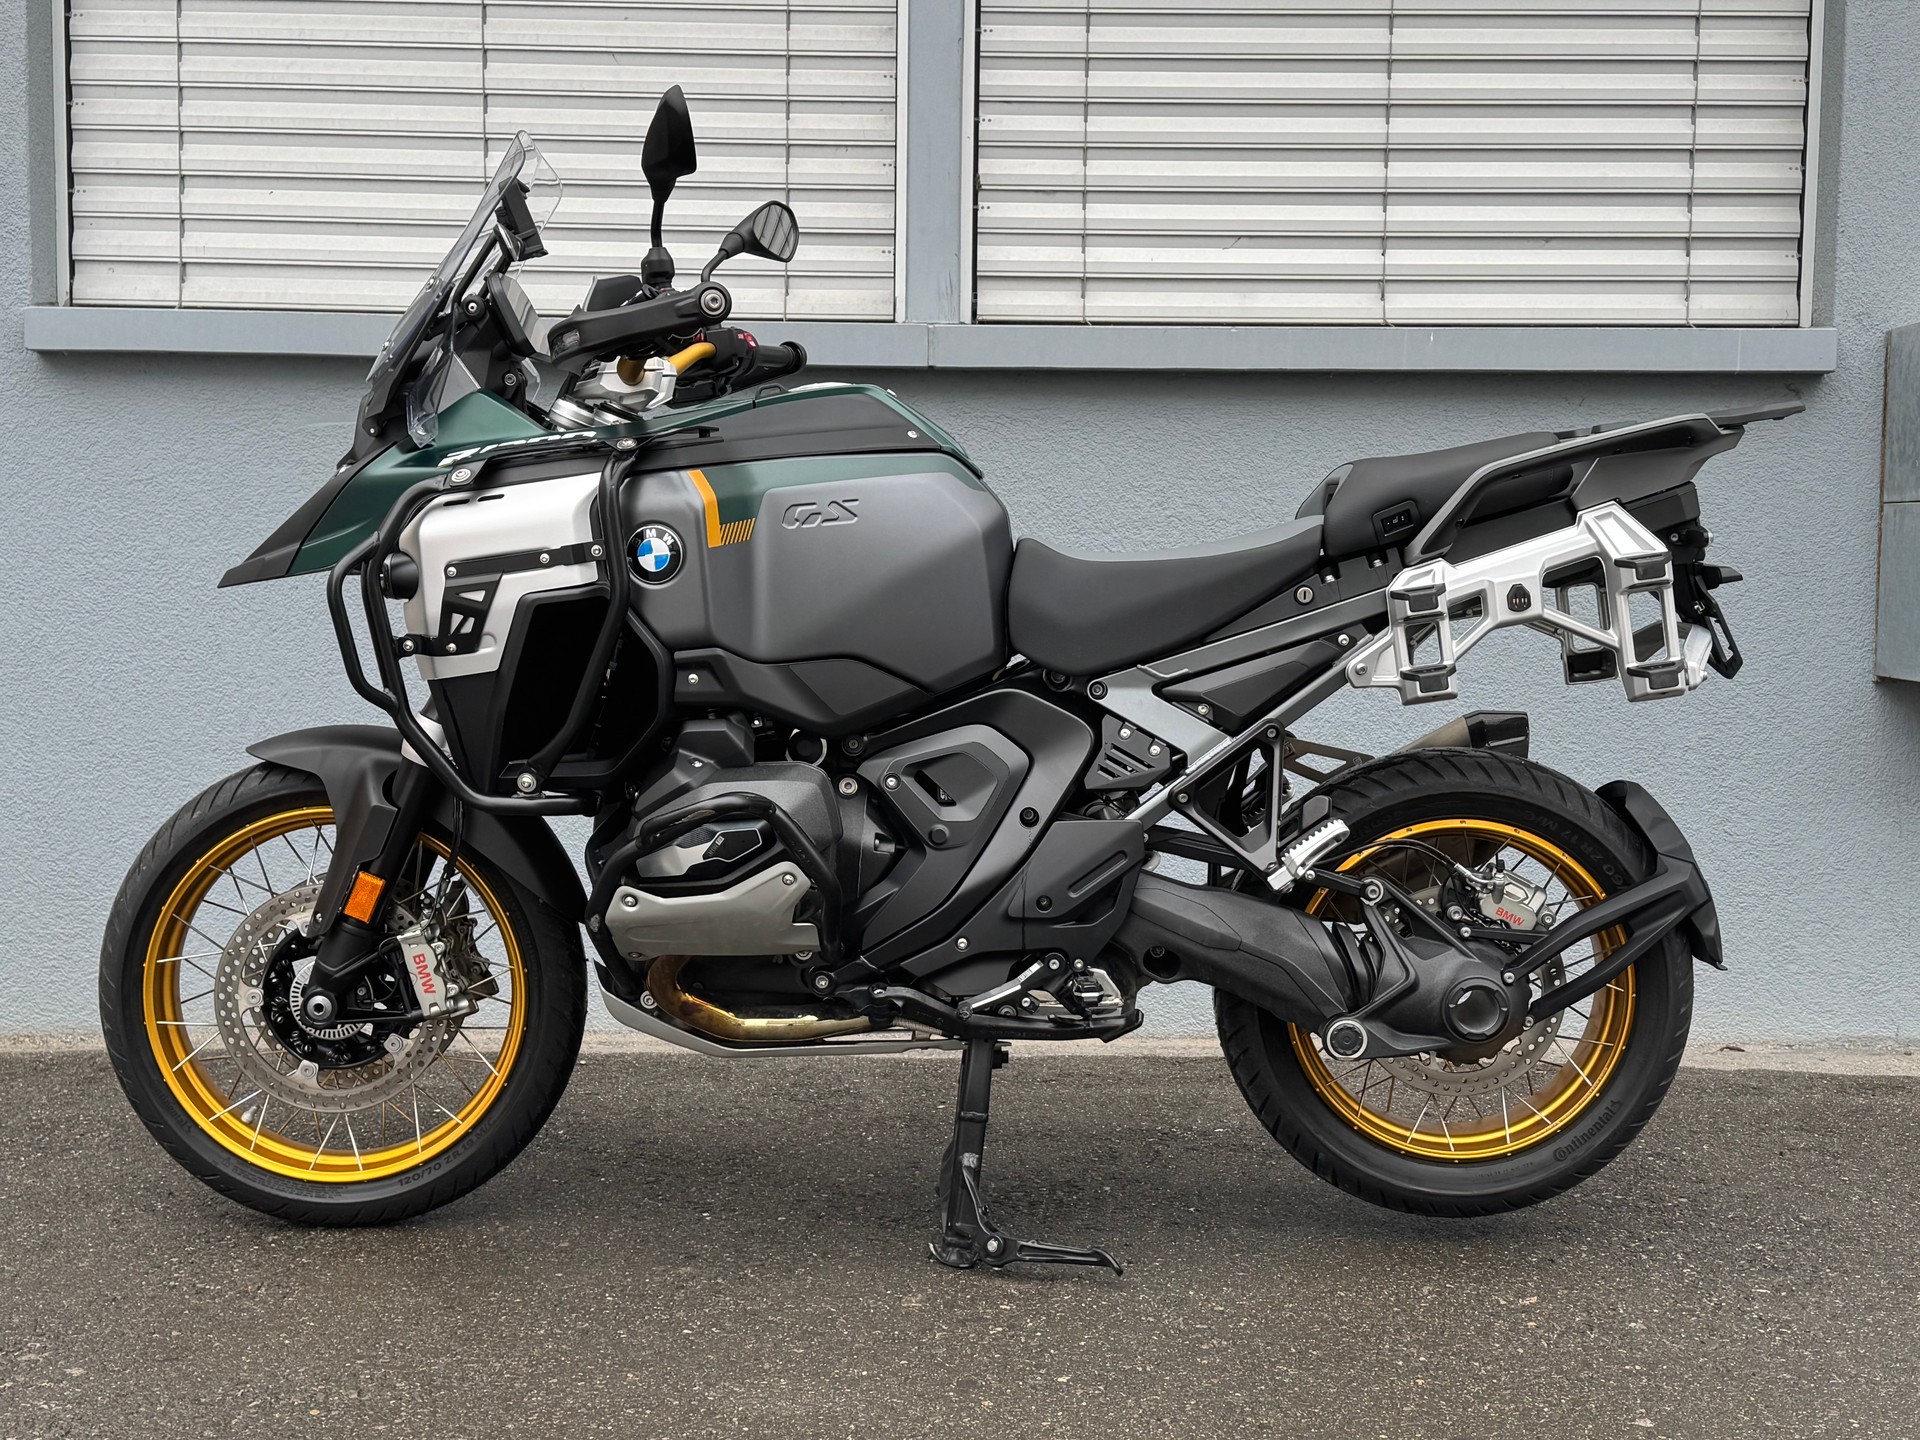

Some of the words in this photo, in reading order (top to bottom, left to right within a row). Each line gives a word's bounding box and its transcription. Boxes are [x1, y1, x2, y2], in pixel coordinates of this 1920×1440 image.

[781, 498, 860, 530] GS
[631, 528, 675, 547] BMW
[1495, 906, 1526, 926] BMW
[412, 953, 437, 995] BMW
[1552, 1107, 1617, 1162] Continental
[397, 1161, 442, 1187] 120/70
